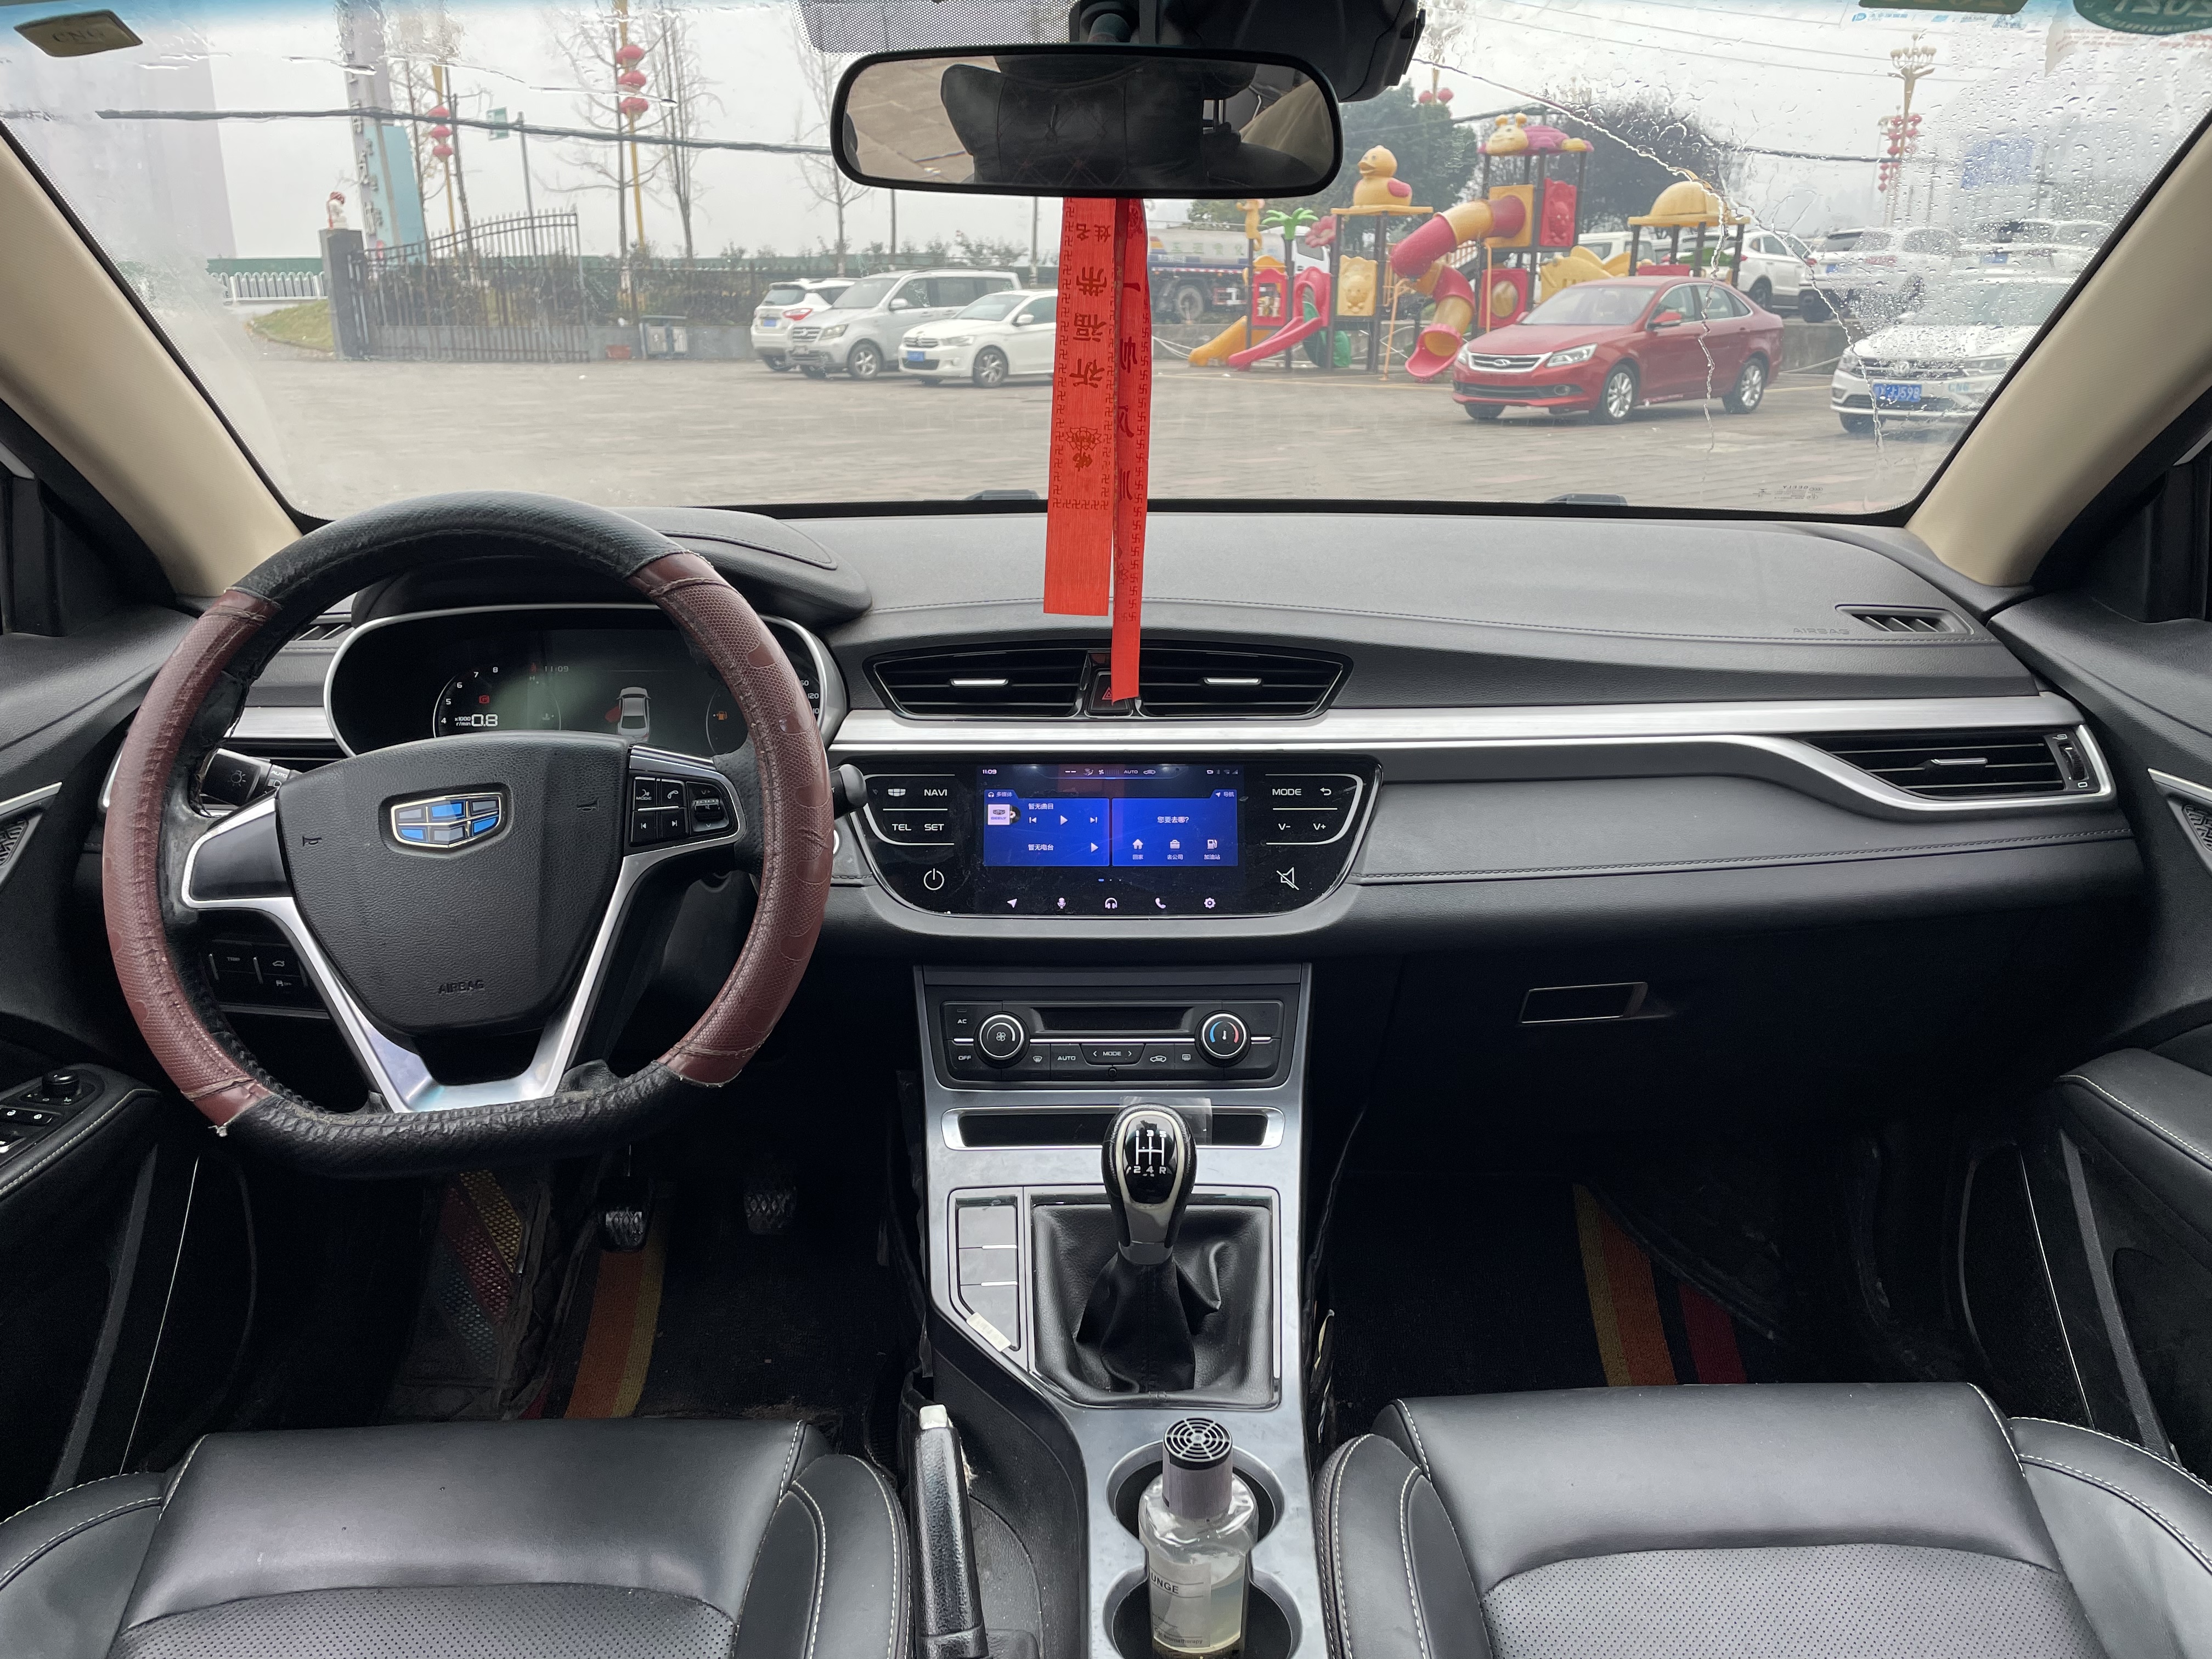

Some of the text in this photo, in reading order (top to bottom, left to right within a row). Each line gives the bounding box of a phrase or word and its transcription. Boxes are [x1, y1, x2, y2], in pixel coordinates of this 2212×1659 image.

[1792, 627, 1850, 635] AIRBAG
[471, 714, 498, 727] 0.8
[270, 770, 288, 778] AUTO
[437, 980, 485, 996] AIRBAG
